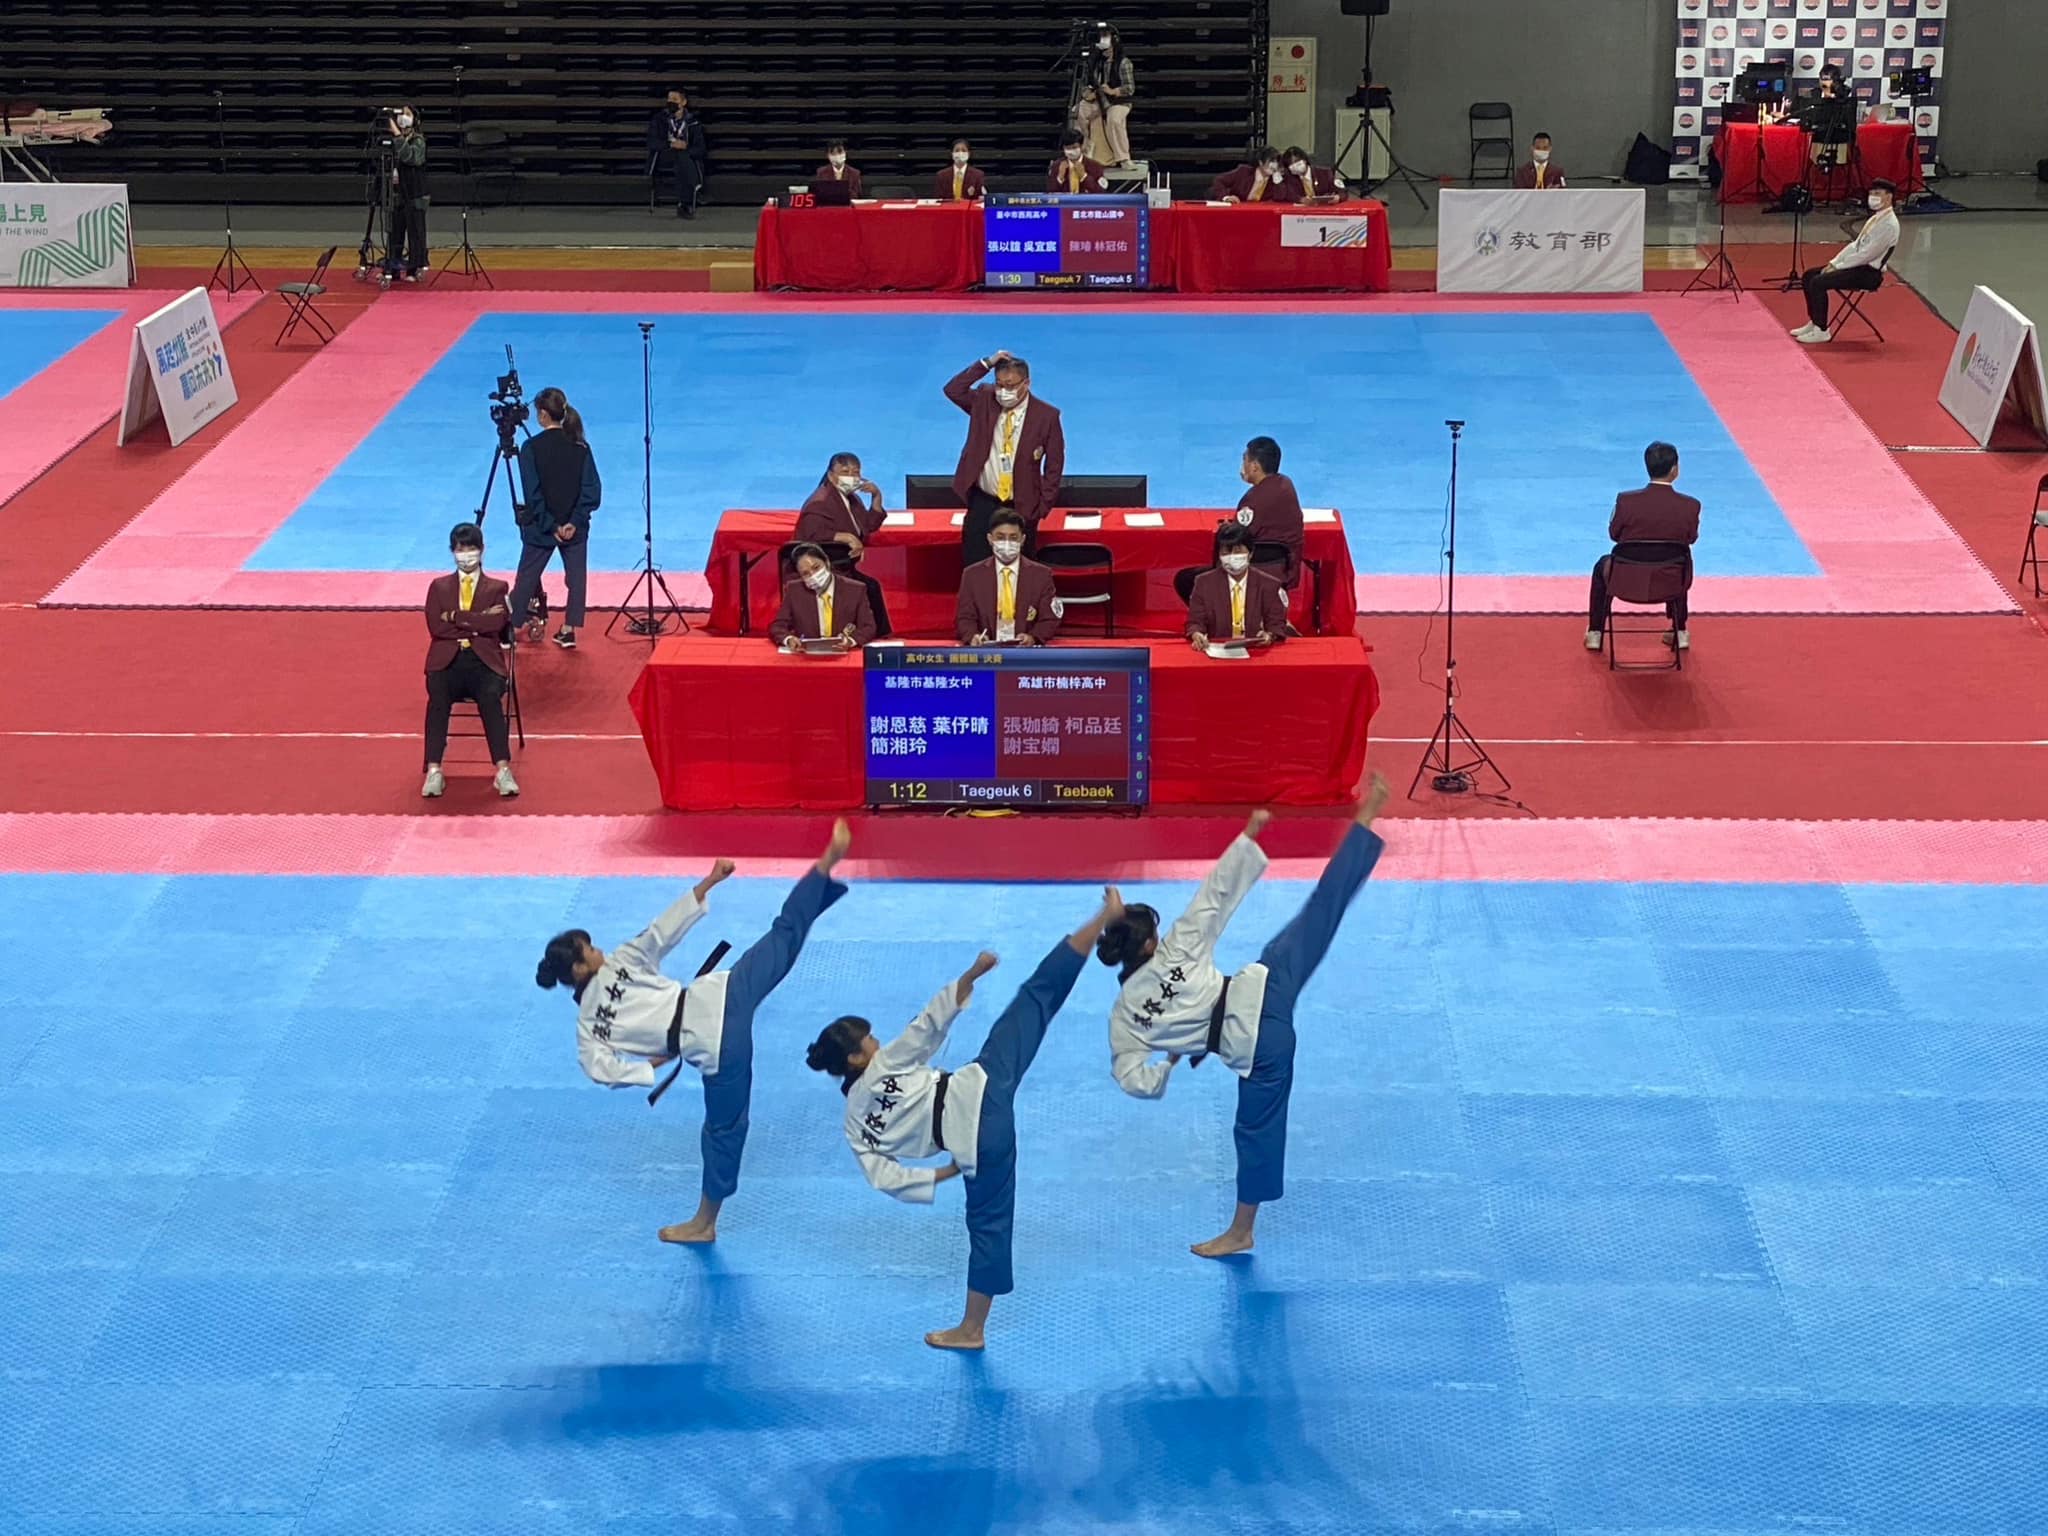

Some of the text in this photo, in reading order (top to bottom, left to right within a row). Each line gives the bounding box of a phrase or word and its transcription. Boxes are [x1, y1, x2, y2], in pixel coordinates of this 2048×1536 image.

[789, 193, 816, 207] 105
[992, 197, 997, 205] 1
[6, 228, 49, 236] THE WIND
[1319, 226, 1327, 242] 1
[1508, 231, 1613, 252] 教育部
[999, 274, 1022, 285] 1:30
[1040, 274, 1081, 285] Taegeuk 7
[1090, 274, 1133, 285] Taegeuk 5
[877, 653, 884, 665] 1
[906, 653, 945, 665] 高中女生
[884, 675, 973, 690] 基隆市基隆女中
[1017, 675, 1107, 690] 高雄市楠梓高中
[1137, 676, 1143, 684] 1
[1136, 695, 1143, 703] 2
[870, 715, 989, 735] 謝恩慈 葉伃晴
[1136, 714, 1143, 724] 3
[1065, 716, 1122, 735] 柯品廷
[1136, 733, 1143, 742] 4
[871, 736, 928, 756] 簡湘玲
[1136, 752, 1143, 761] 5
[1136, 771, 1143, 780] 6
[889, 783, 927, 798] 1:12
[959, 784, 1032, 800] Taegeuk 6
[1054, 784, 1114, 798] Taebaek
[1136, 789, 1143, 799] 7
